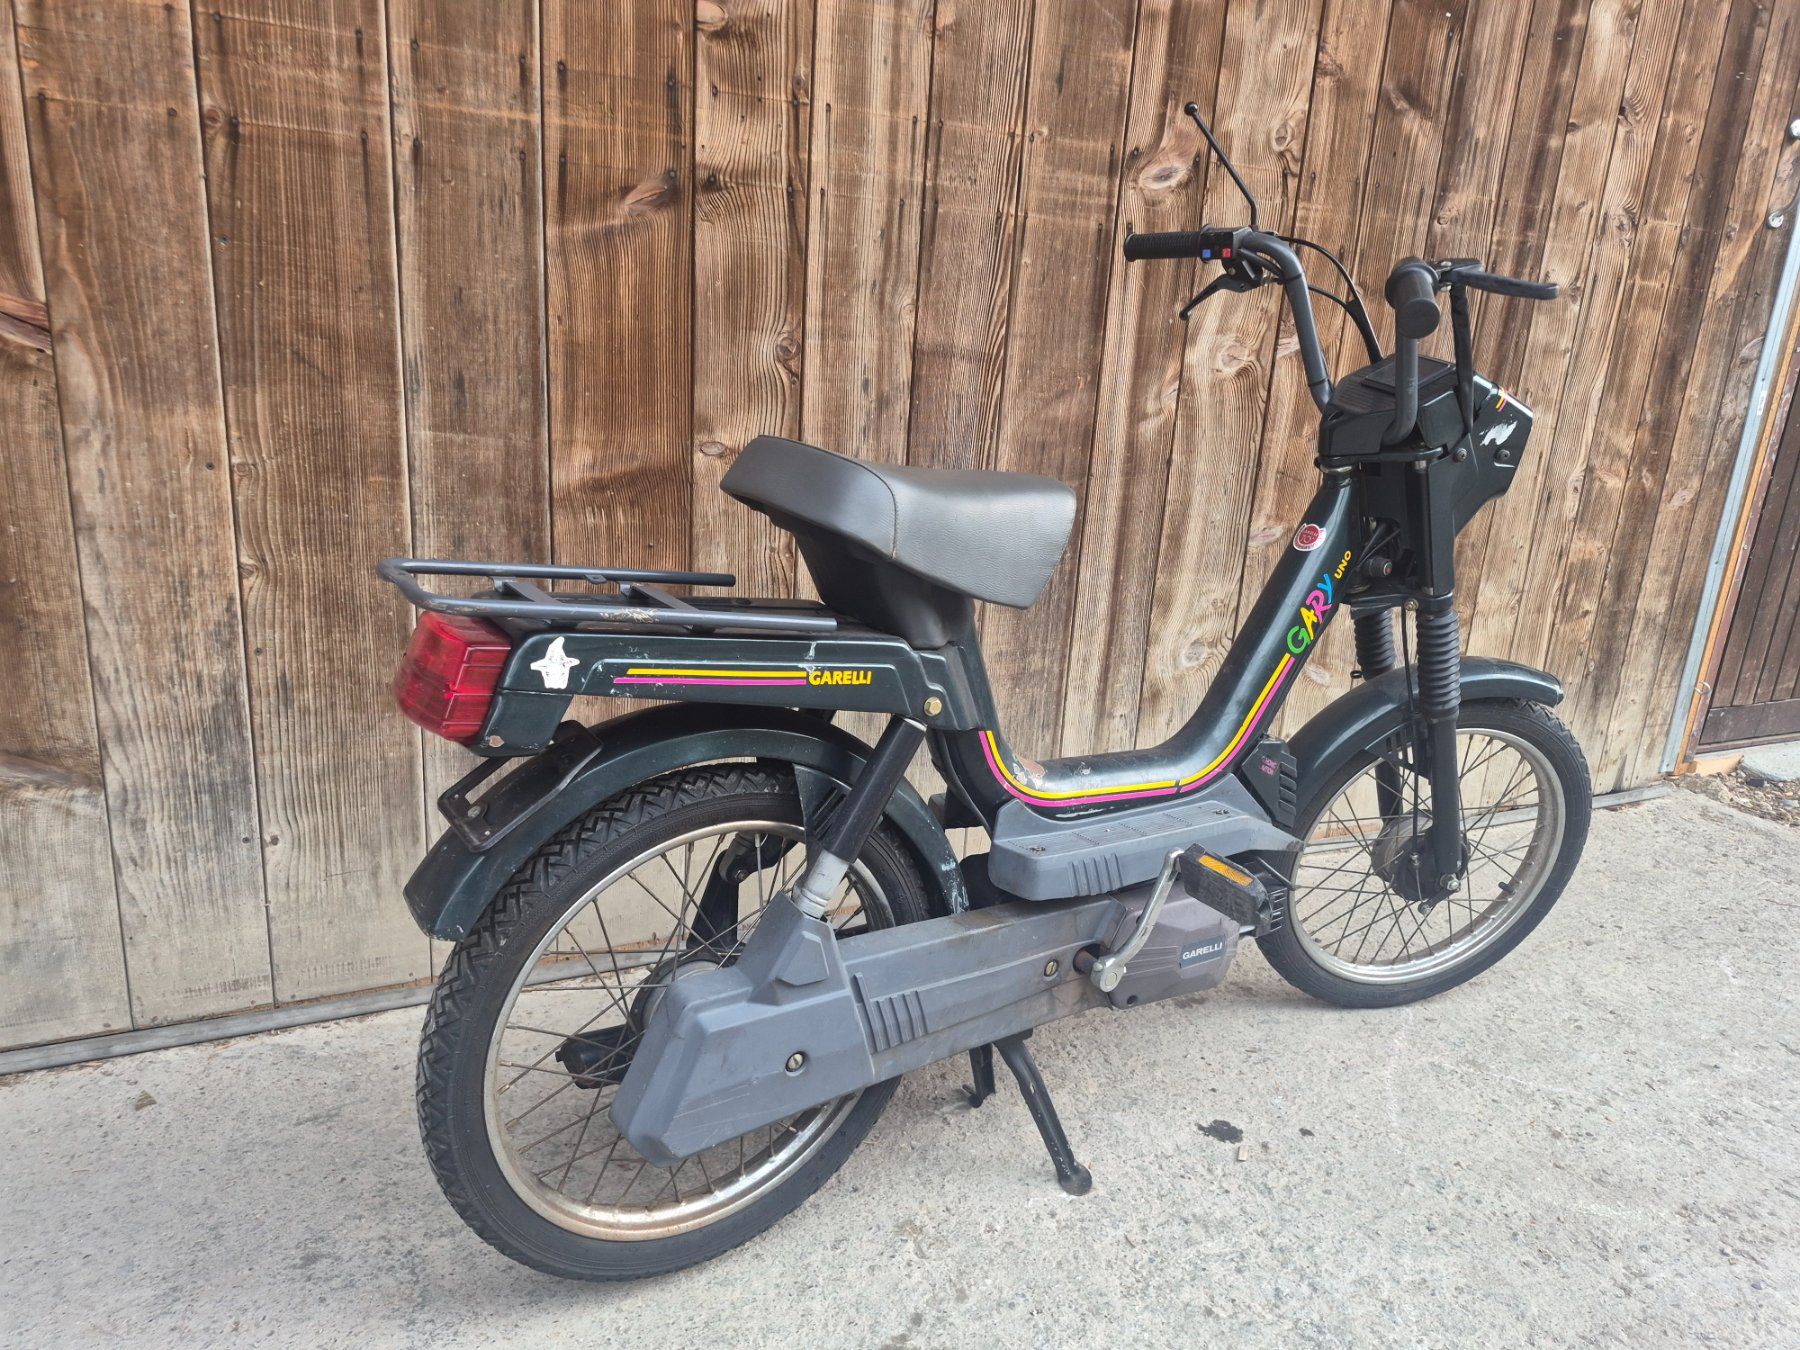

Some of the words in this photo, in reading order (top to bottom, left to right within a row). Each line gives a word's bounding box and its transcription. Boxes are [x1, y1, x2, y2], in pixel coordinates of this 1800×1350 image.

[1286, 573, 1334, 655] GARY
[1333, 549, 1352, 580] UNO
[808, 670, 873, 687] GARELLI
[1182, 942, 1223, 960] GARELLI
